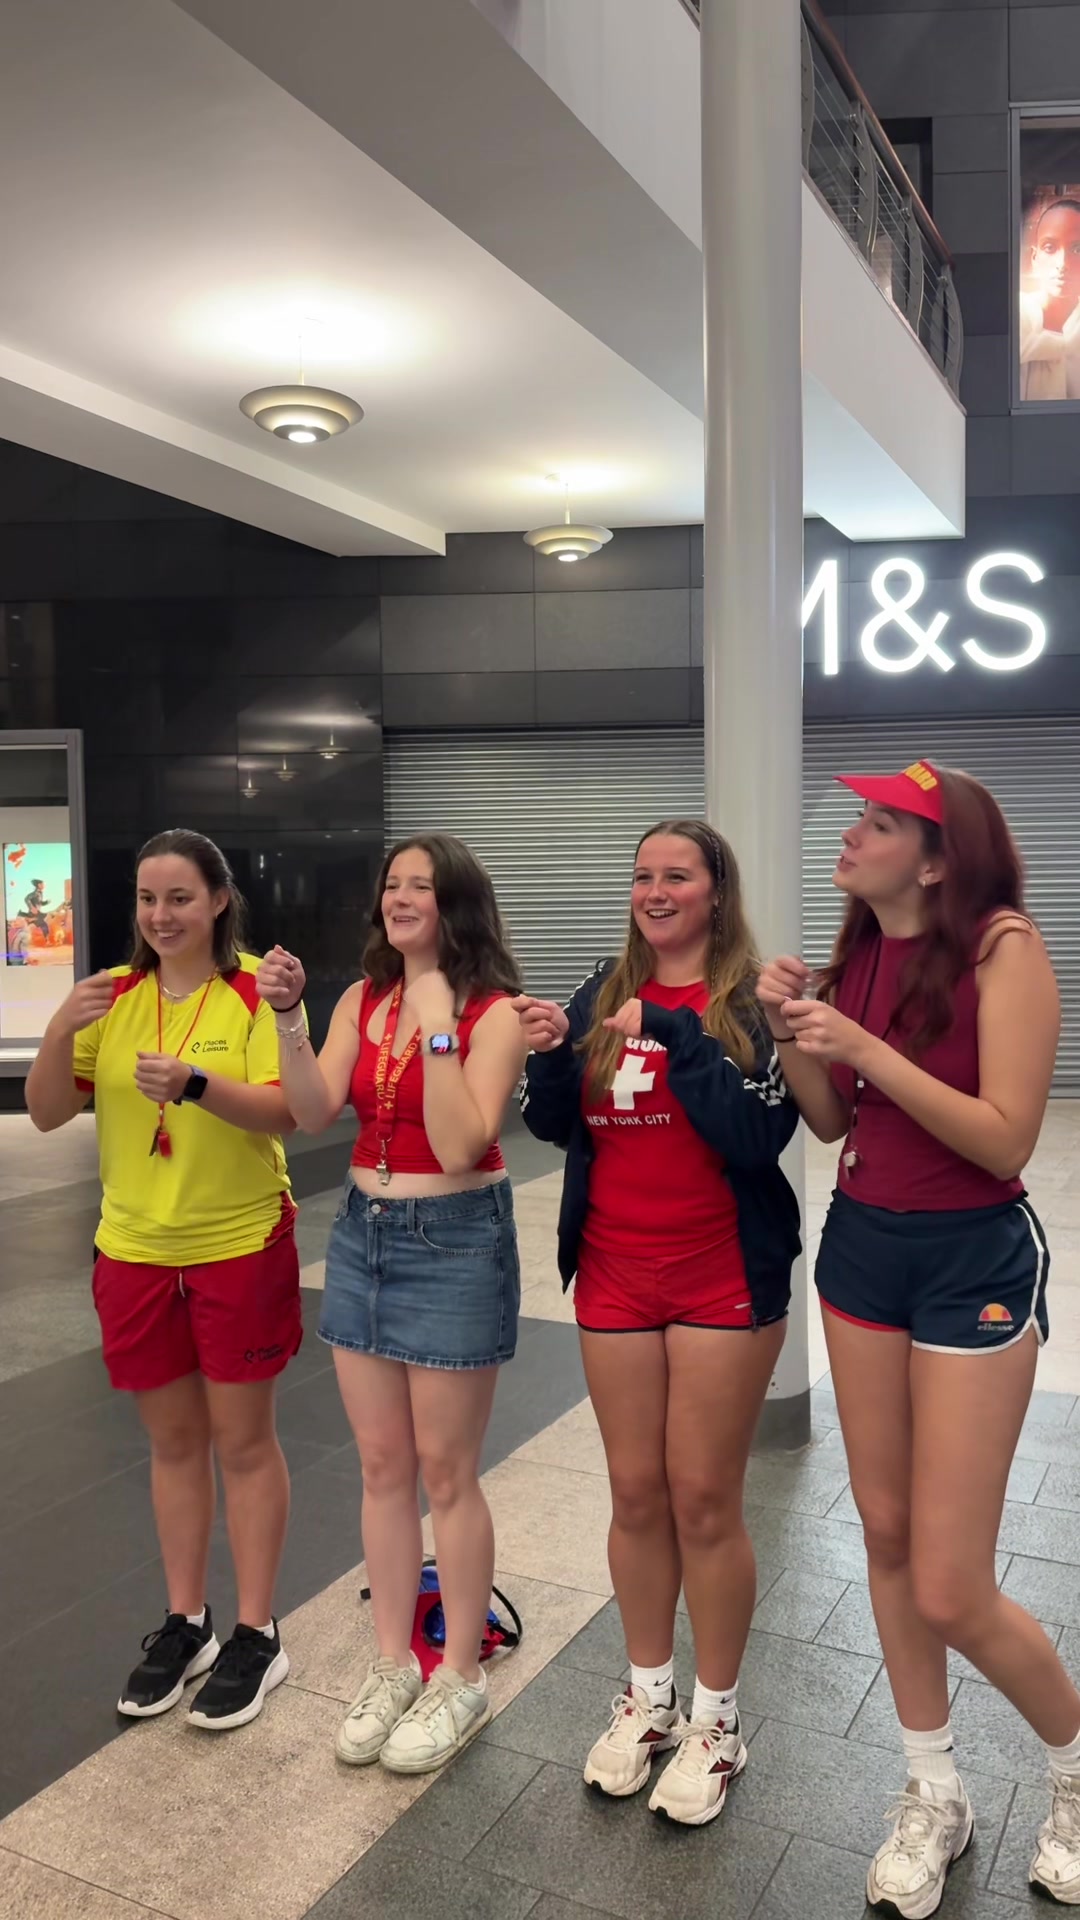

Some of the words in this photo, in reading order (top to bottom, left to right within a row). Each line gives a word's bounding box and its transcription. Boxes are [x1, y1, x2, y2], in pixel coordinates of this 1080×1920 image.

[375, 1041, 391, 1100] LIFEGUARD
[385, 1042, 418, 1099] LIFEGUARD
[586, 1115, 609, 1126] NEW
[610, 1116, 643, 1126] YORK
[644, 1113, 671, 1125] CITY
[977, 1322, 1015, 1331] ellesse
